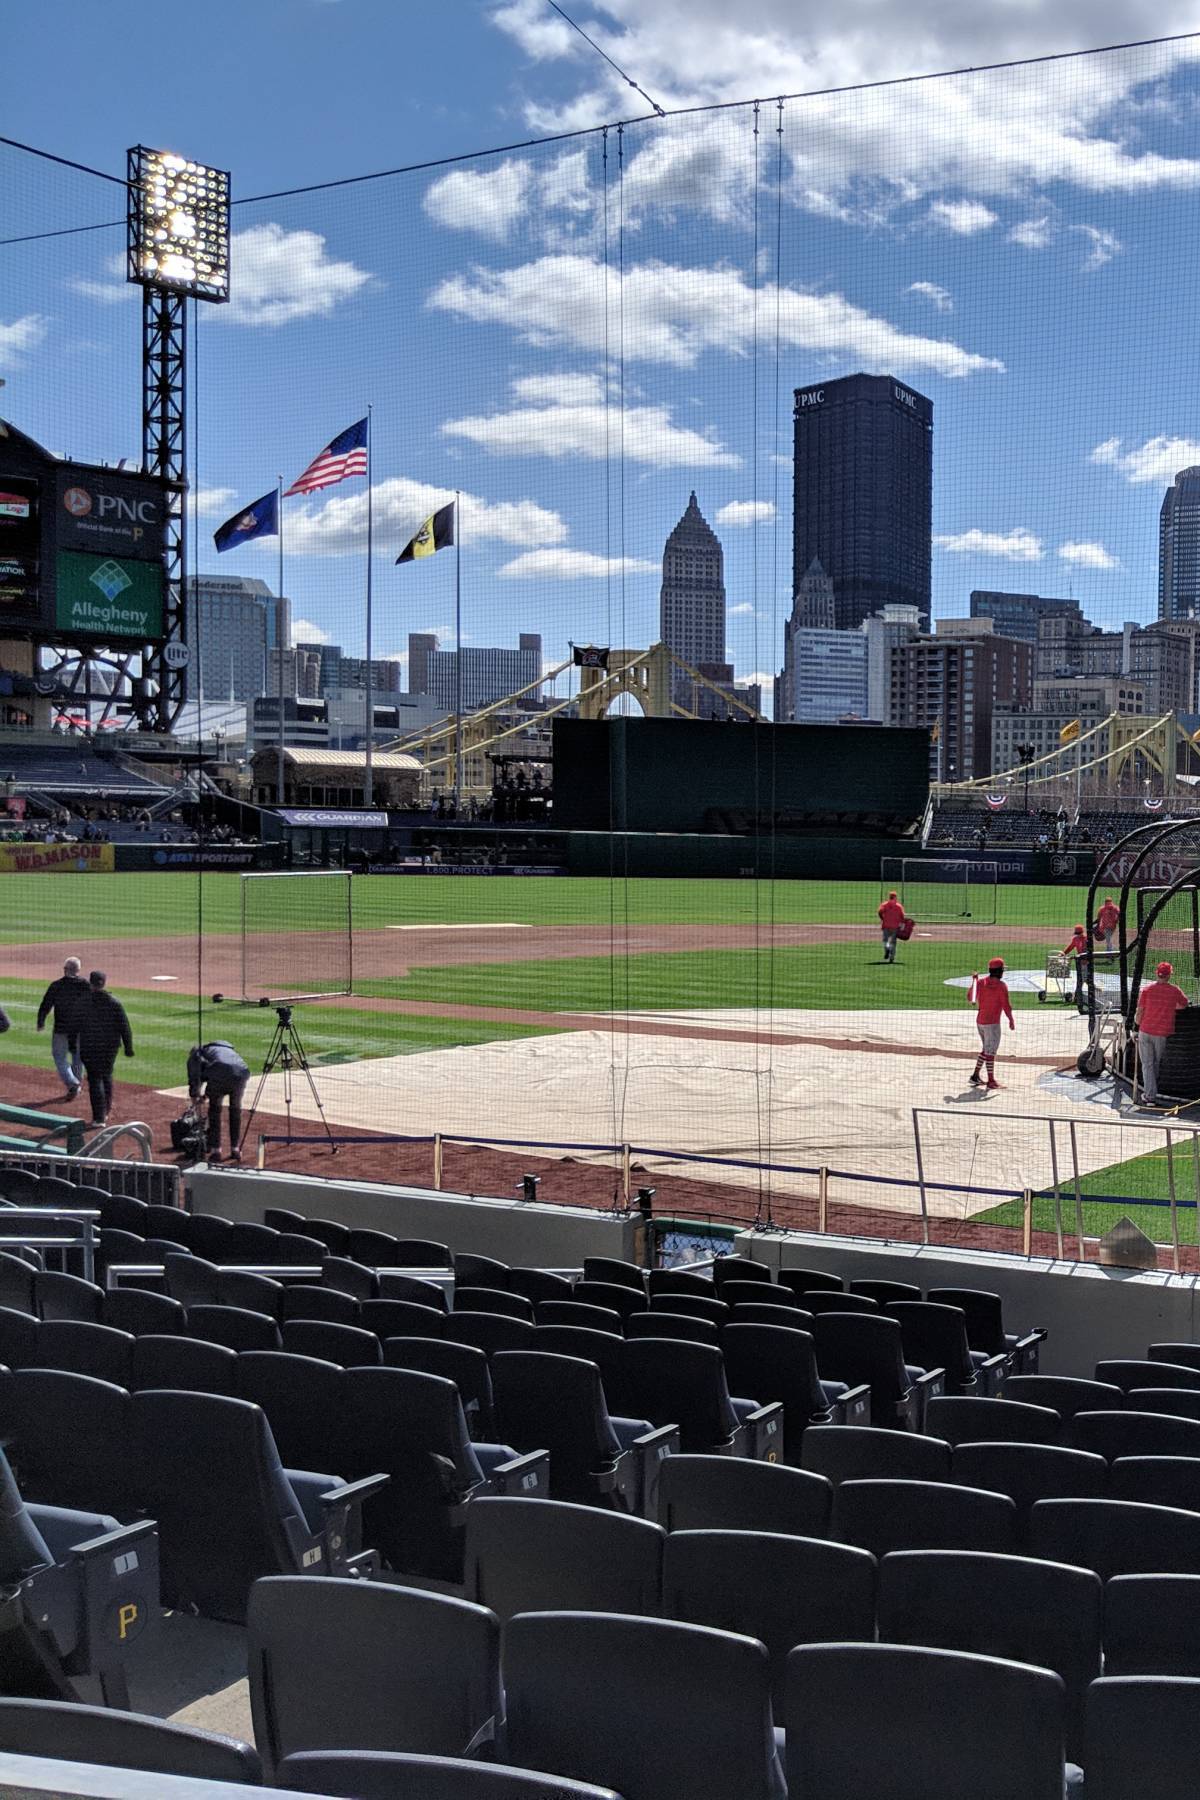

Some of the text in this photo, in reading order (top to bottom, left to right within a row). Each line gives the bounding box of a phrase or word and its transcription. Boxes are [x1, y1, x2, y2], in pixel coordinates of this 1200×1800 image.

[794, 390, 825, 408] UPMC
[894, 386, 917, 409] UPMC
[96, 494, 157, 524] PNC
[191, 580, 243, 590] Federated
[71, 602, 149, 625] Allegheny
[71, 619, 147, 636] Health Network
[316, 813, 382, 822] GUARDIAN
[168, 853, 253, 864] AT&T SPORTSNET
[119, 1603, 138, 1639] P
